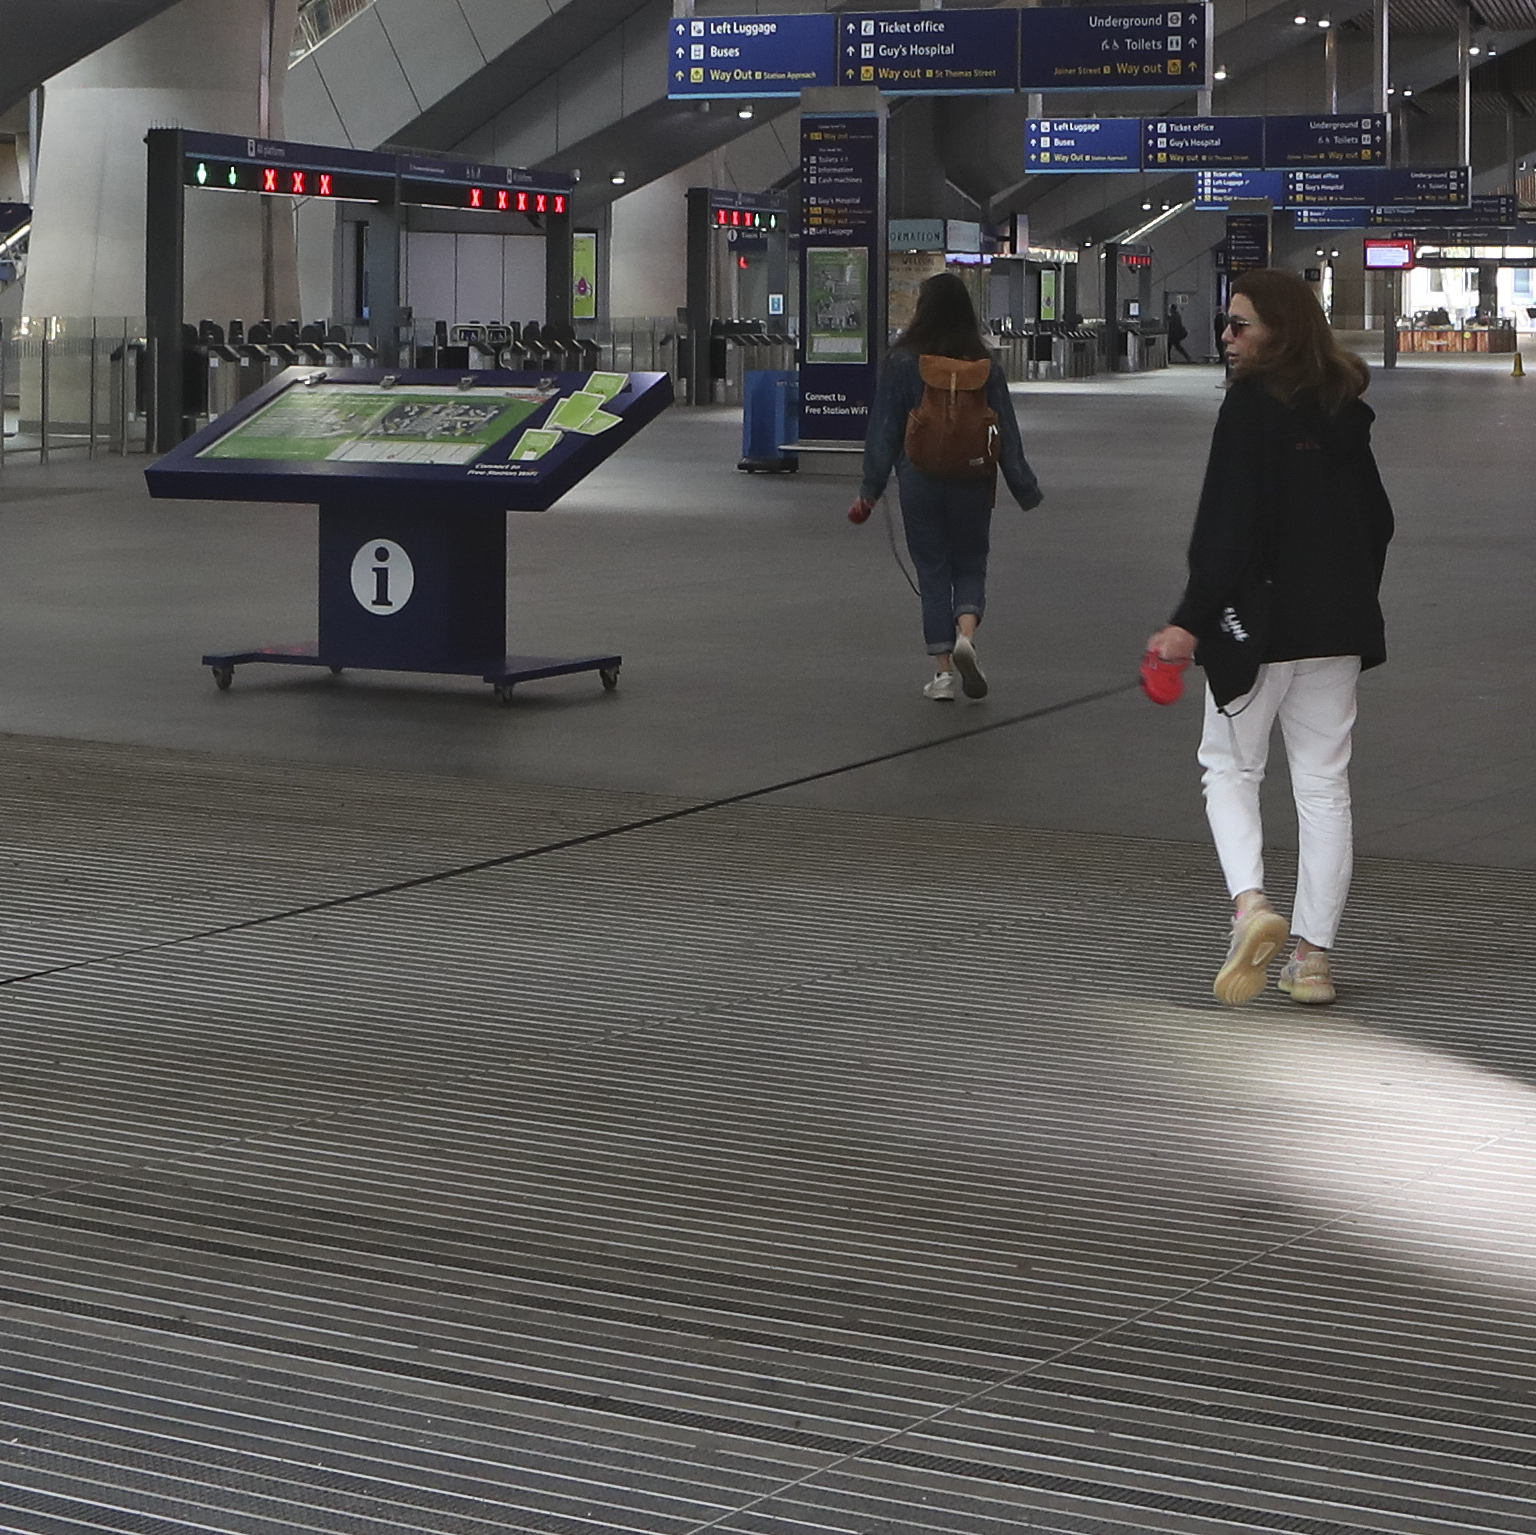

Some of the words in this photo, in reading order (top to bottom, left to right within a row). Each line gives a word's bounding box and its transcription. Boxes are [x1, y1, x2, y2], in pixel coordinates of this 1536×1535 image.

[710, 22, 731, 34] Left
[733, 21, 777, 36] Luggage
[879, 21, 911, 33] Ticket
[914, 20, 945, 33] office
[1089, 15, 1162, 29] Underground
[879, 45, 907, 58] Guy's
[910, 43, 955, 58] Hospital
[1124, 38, 1163, 50] Toilets
[710, 46, 740, 58] Buses
[710, 69, 731, 82] Way
[733, 69, 752, 80] Out
[878, 69, 901, 81] Way
[903, 68, 921, 78] out
[1116, 63, 1139, 76] Way
[1143, 63, 1162, 74] out
[890, 232, 941, 242] ORMATION
[805, 392, 836, 402] Connect
[837, 393, 846, 401] to
[805, 406, 821, 414] Free
[822, 406, 850, 415] Station
